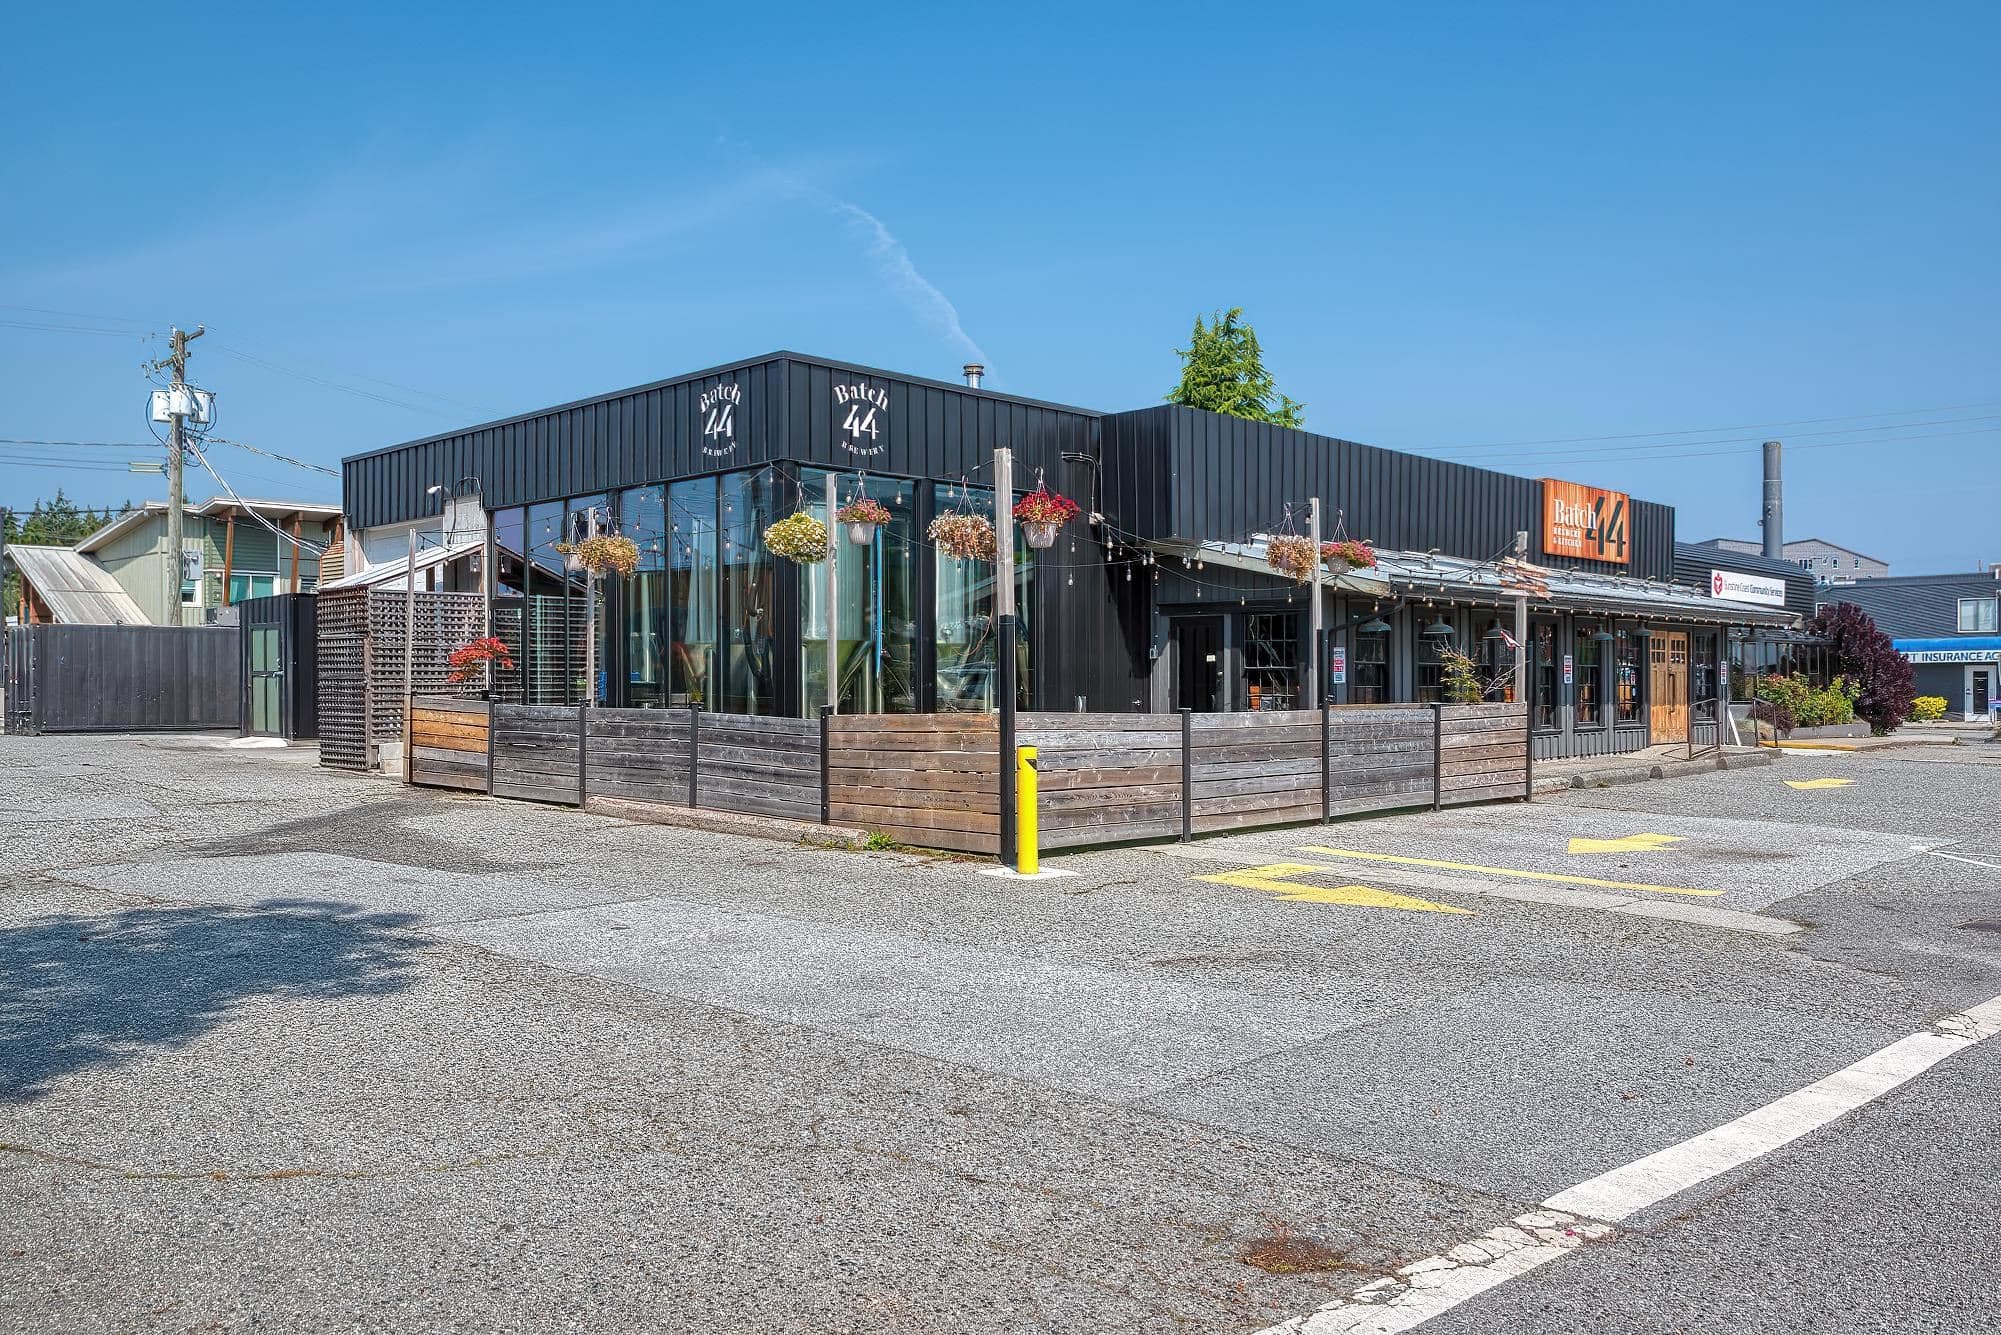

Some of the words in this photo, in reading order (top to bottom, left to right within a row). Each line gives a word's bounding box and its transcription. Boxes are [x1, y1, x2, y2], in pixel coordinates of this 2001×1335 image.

[700, 383, 741, 413] Batch
[834, 383, 888, 412] Batch
[705, 405, 732, 440] 44
[843, 405, 880, 440] 44
[841, 441, 884, 456] BREWERY
[1553, 499, 1597, 529] Batch
[1585, 496, 1627, 557] 44
[1922, 652, 1983, 662] INSURANCE
